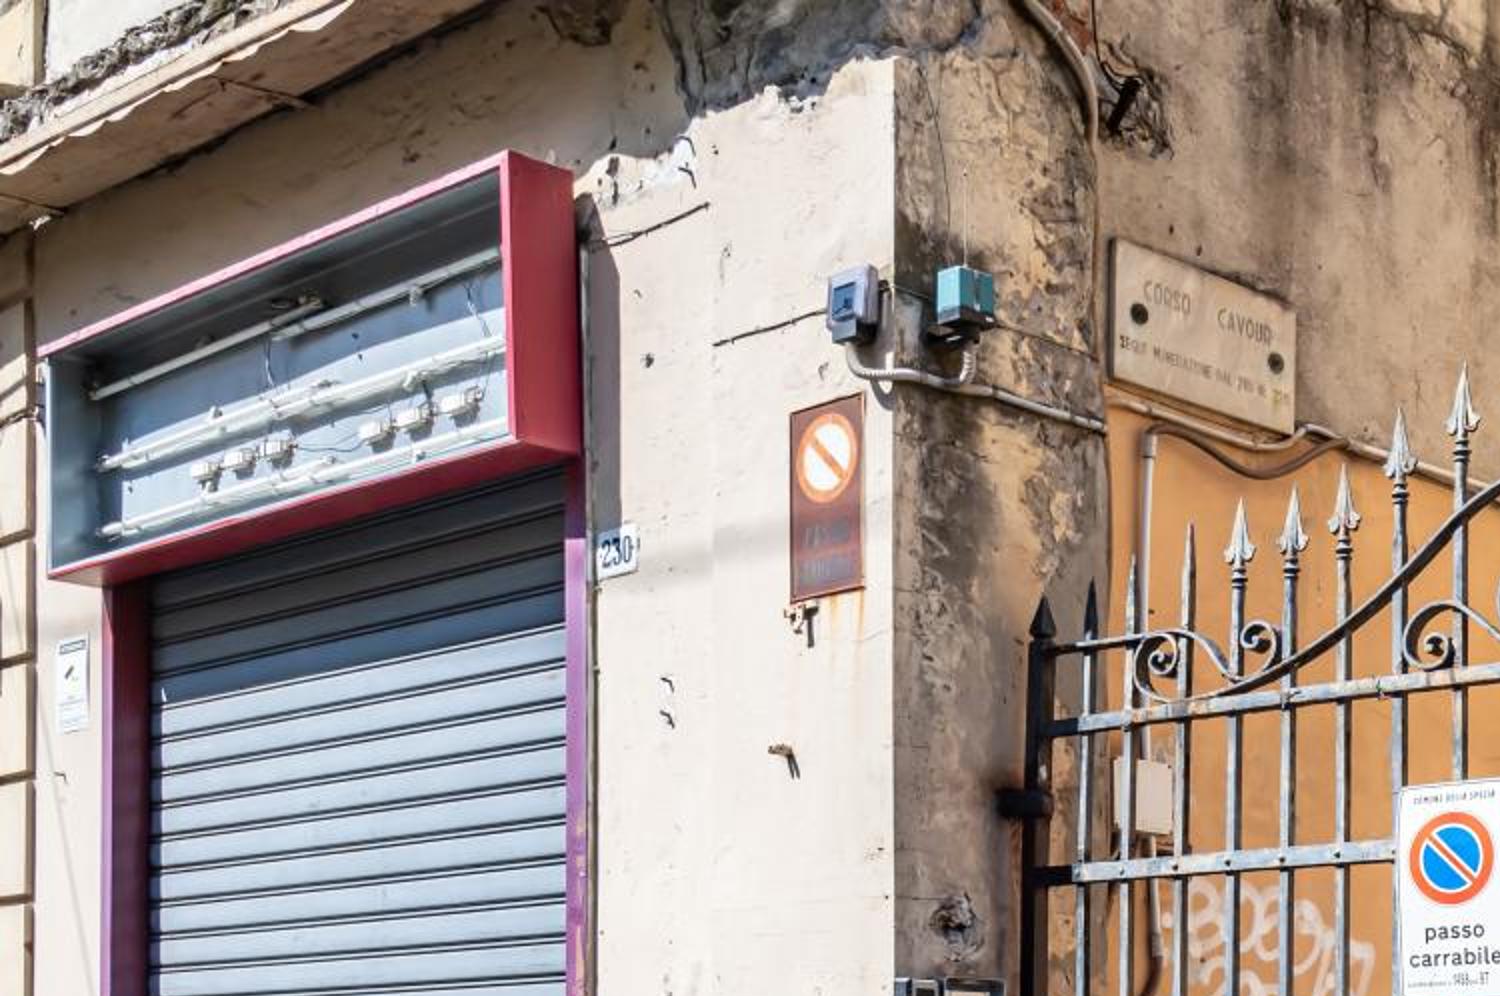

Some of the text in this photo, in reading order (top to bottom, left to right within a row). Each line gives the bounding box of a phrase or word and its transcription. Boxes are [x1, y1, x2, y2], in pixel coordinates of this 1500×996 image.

[1143, 280, 1273, 346] CORSO CAVOUR
[601, 535, 634, 568] 230
[1425, 923, 1485, 943] passo
